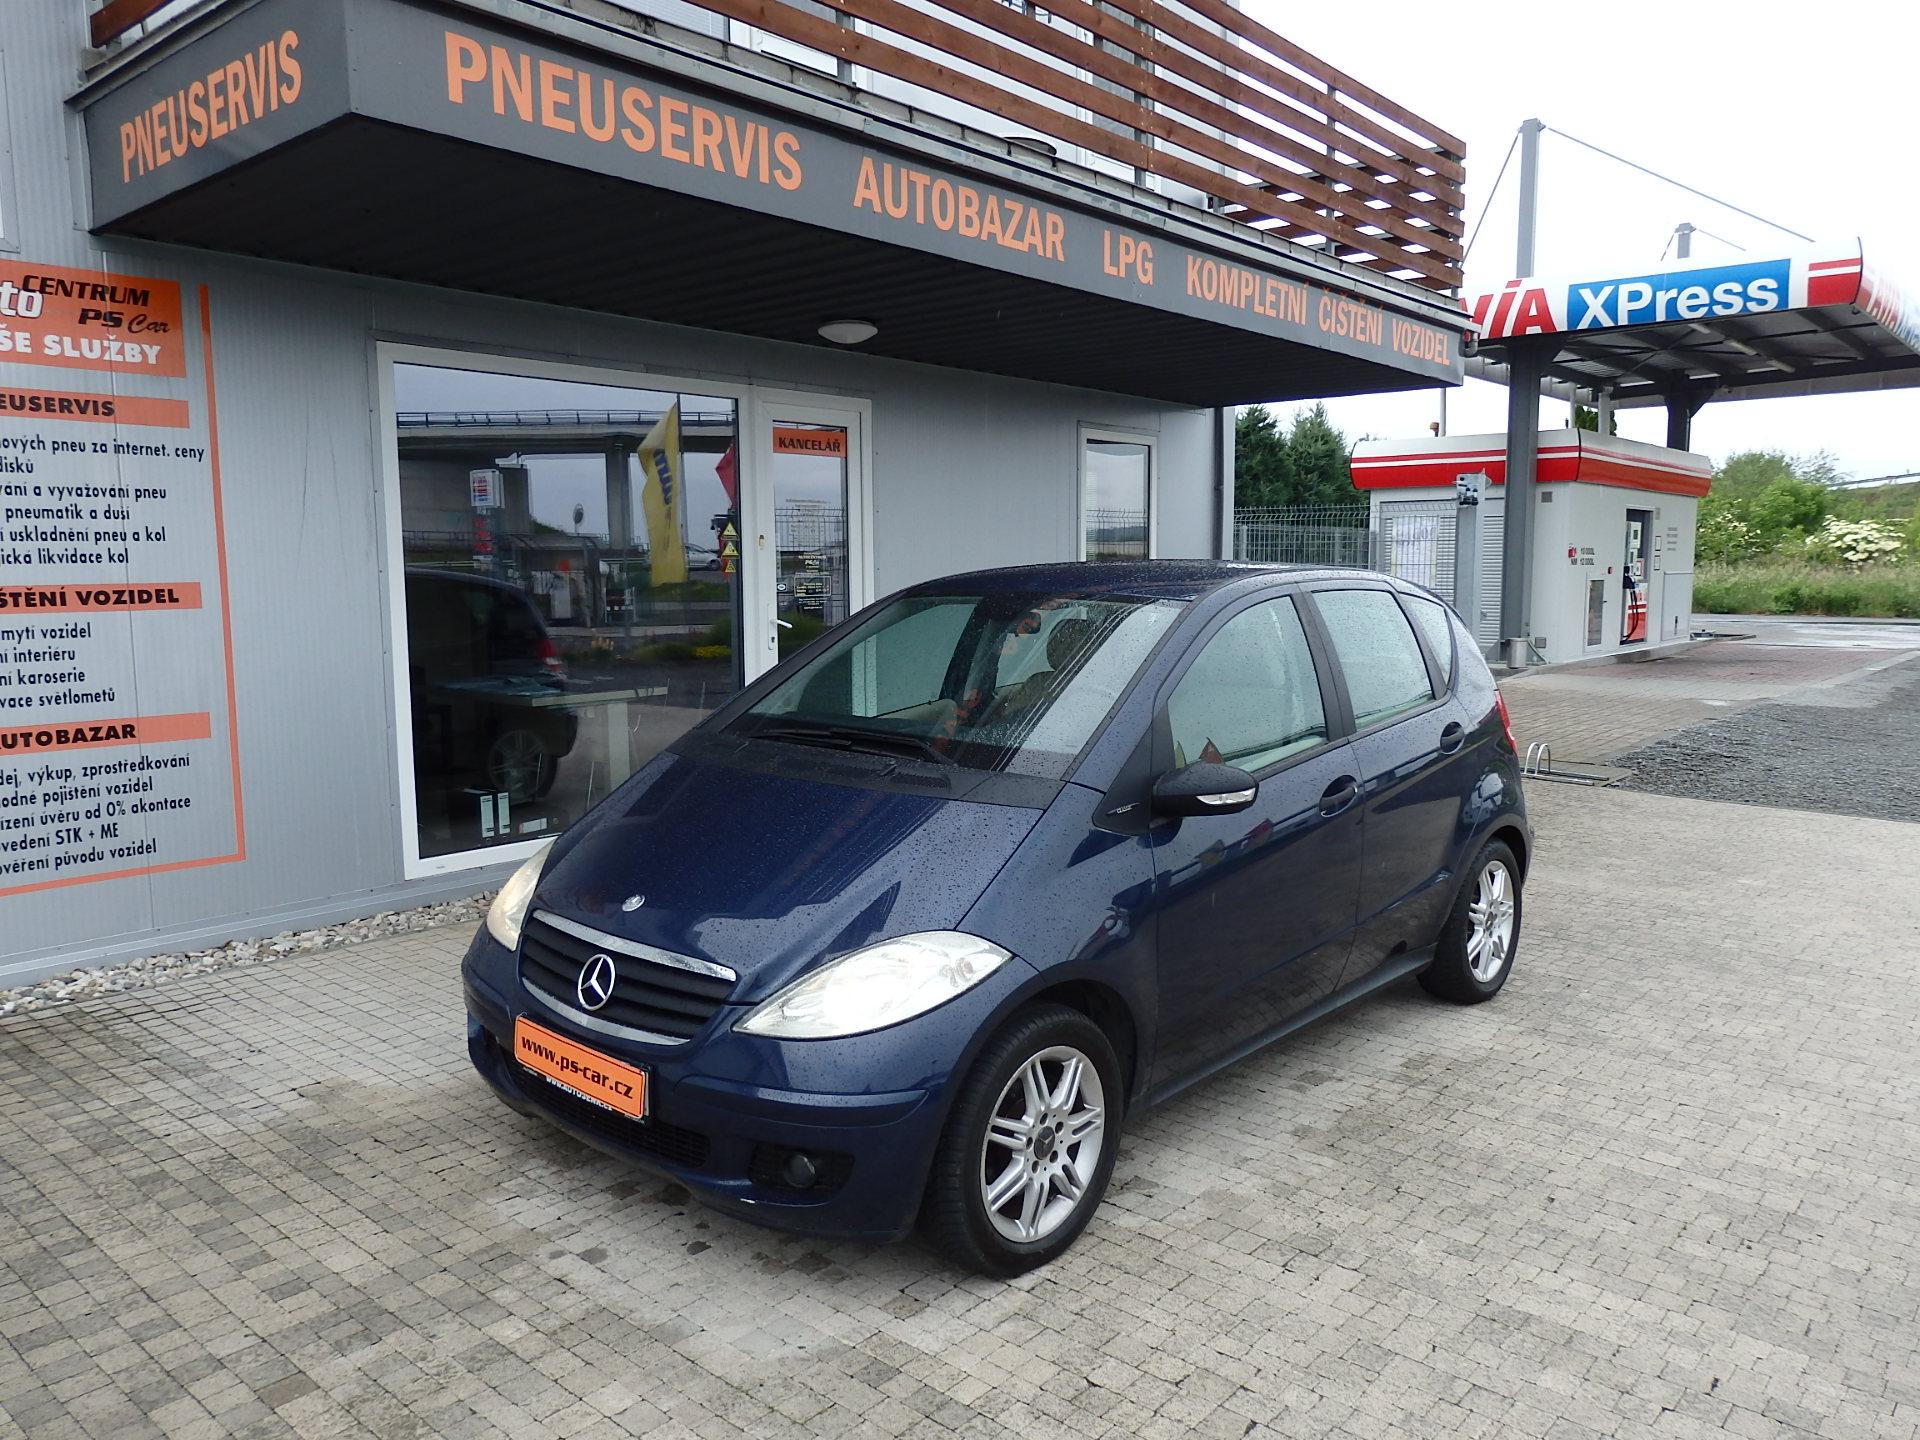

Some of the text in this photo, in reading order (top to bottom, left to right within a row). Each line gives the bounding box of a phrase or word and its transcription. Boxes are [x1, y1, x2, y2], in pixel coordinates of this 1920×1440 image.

[120, 30, 302, 184] PNEUSERVIS
[445, 31, 802, 191] PNEUSERVIS
[853, 156, 1065, 262] AUTOBAZAR
[1103, 229, 1154, 286] LPG
[1186, 255, 1310, 325] KOMPLETNÍ
[1392, 318, 1450, 366] VOZIDEL
[22, 274, 150, 307] CENTRUM
[1576, 278, 1779, 330] XPress
[78, 308, 171, 334] PS Car
[43, 332, 161, 365] SLUŽBY
[0, 433, 205, 462] ových pneu za internet. ceny
[778, 436, 841, 452] KANCELÁŘ
[33, 485, 41, 496] a
[48, 482, 129, 501] vyvažování
[135, 486, 167, 500] pneu
[6, 503, 83, 523] pneumatik
[90, 509, 98, 519] a
[10, 525, 89, 542] uskladnění
[94, 530, 127, 545] pneu
[132, 531, 140, 541] a
[146, 526, 166, 542] kol
[38, 547, 102, 564] likvidace
[108, 547, 129, 563] kol
[75, 588, 179, 606] VOZIDEL
[1, 622, 91, 645] mytí vozidel
[13, 645, 76, 663] interiéru
[17, 667, 85, 685] karoserie
[39, 688, 115, 707] světlometů
[0, 723, 136, 749] UTOBAZAR
[28, 765, 76, 786] výkup,
[82, 753, 190, 780] zprostředkování
[43, 783, 101, 807] pojištění
[106, 776, 153, 796] vozidel
[40, 810, 80, 826] úvěru
[85, 803, 101, 820] od
[106, 800, 126, 817] 0%
[131, 796, 191, 814] akontace
[55, 827, 83, 846] STK
[101, 822, 119, 840] ME
[55, 846, 104, 871] původu
[110, 838, 157, 859] vozidel
[521, 1036, 633, 1099] www.ps-car.cz
